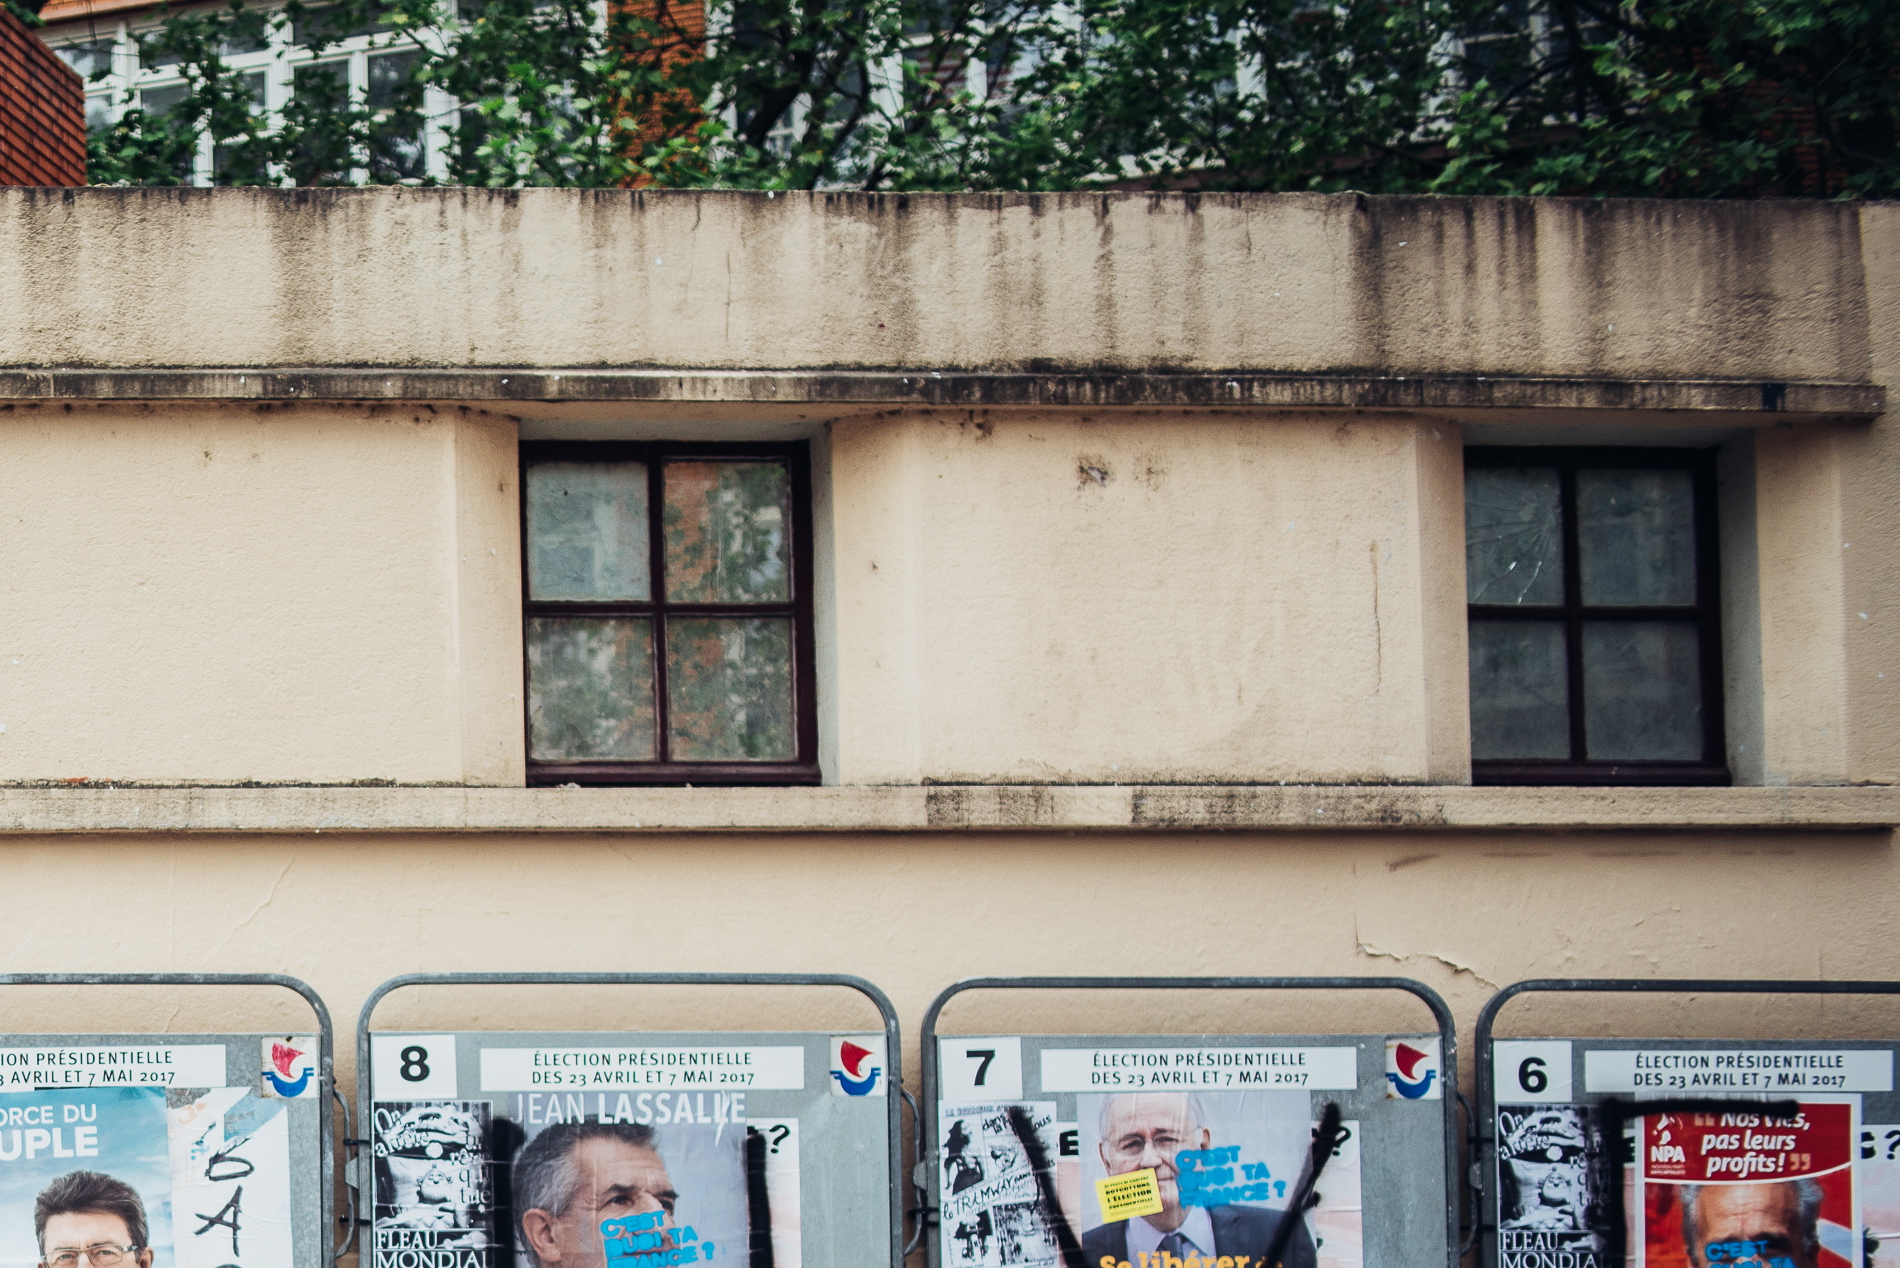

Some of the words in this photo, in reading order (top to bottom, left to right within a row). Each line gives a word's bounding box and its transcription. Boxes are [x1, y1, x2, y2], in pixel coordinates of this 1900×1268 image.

[36, 1050, 173, 1066] PRÉSIDENTIELLE
[400, 1045, 431, 1082] 8
[534, 1050, 611, 1066] ÉLECTION
[618, 1050, 752, 1066] PRÉSIDENTIELLE
[966, 1049, 996, 1086] 7
[1093, 1051, 1169, 1067] ÉLECTION
[1176, 1051, 1306, 1067] PRÉSIDENTIELLE
[1636, 1053, 1709, 1069] ÉLECTION
[1716, 1054, 1844, 1069] PRÉSIDENTIELLE
[11, 1070, 58, 1084] AVRIL
[64, 1070, 83, 1083] ET
[88, 1072, 96, 1086] 7
[103, 1069, 133, 1083] MAI
[140, 1072, 175, 1085] 2017
[532, 1071, 562, 1084] DES
[569, 1074, 587, 1087] 23
[593, 1071, 640, 1084] AVRIL
[645, 1071, 664, 1083] ET
[669, 1073, 676, 1086] 7
[683, 1070, 713, 1083] MAI
[720, 1073, 755, 1086] 2017
[1091, 1071, 1121, 1085] DES
[1127, 1073, 1145, 1088] 23
[1151, 1071, 1196, 1085] AVRIL
[1202, 1071, 1221, 1085] ET
[1226, 1074, 1233, 1088] 7
[1239, 1071, 1268, 1084] MAI
[1275, 1073, 1309, 1087] 2017
[1518, 1057, 1548, 1093] 6
[1634, 1073, 1662, 1086] DES
[1668, 1075, 1686, 1088] 23
[1691, 1073, 1737, 1086] AVRIL
[1742, 1073, 1760, 1086] ET
[1764, 1075, 1772, 1088] 7
[1777, 1074, 1806, 1086] MAI
[1812, 1075, 1846, 1088] 2017
[63, 1104, 97, 1123] DU
[510, 1093, 585, 1125] JEAN
[598, 1092, 746, 1125] LASSALLE
[1701, 1132, 1741, 1155] pas
[1744, 1130, 1796, 1150] leurs
[1651, 1146, 1686, 1162] NPA
[1241, 1162, 1272, 1181] TA
[1706, 1152, 1785, 1178] profits!
[601, 1210, 666, 1237] C'EST
[376, 1230, 438, 1250] FLEAU
[667, 1226, 698, 1245] TA
[1501, 1231, 1559, 1250] FLEAU
[1705, 1240, 1769, 1262] C'EST
